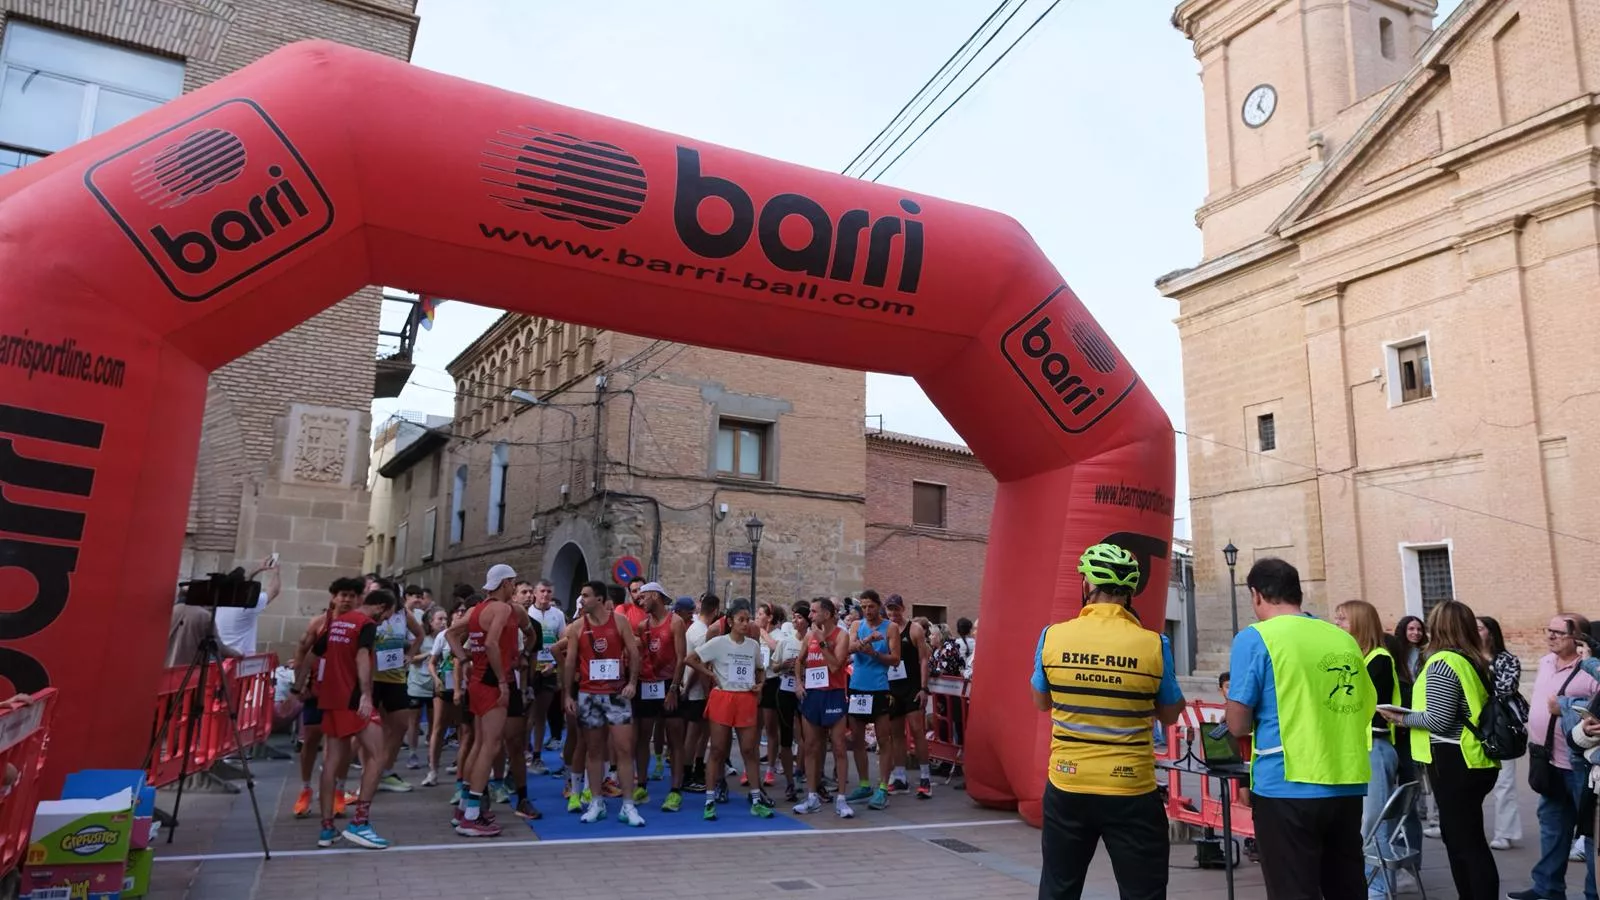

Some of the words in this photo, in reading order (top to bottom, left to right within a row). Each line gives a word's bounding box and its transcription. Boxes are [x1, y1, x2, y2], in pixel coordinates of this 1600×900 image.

[149, 164, 310, 275] barri
[673, 144, 926, 295] barri
[478, 222, 916, 317] www.barri-ball.com
[1021, 316, 1105, 416] barri
[386, 653, 398, 663] 26
[1062, 651, 1138, 670] BIKE-RUN
[736, 666, 747, 675] 86
[811, 671, 825, 681] 100
[1075, 673, 1122, 685] ALCOLEA
[649, 684, 658, 693] 13
[857, 698, 867, 707] 48
